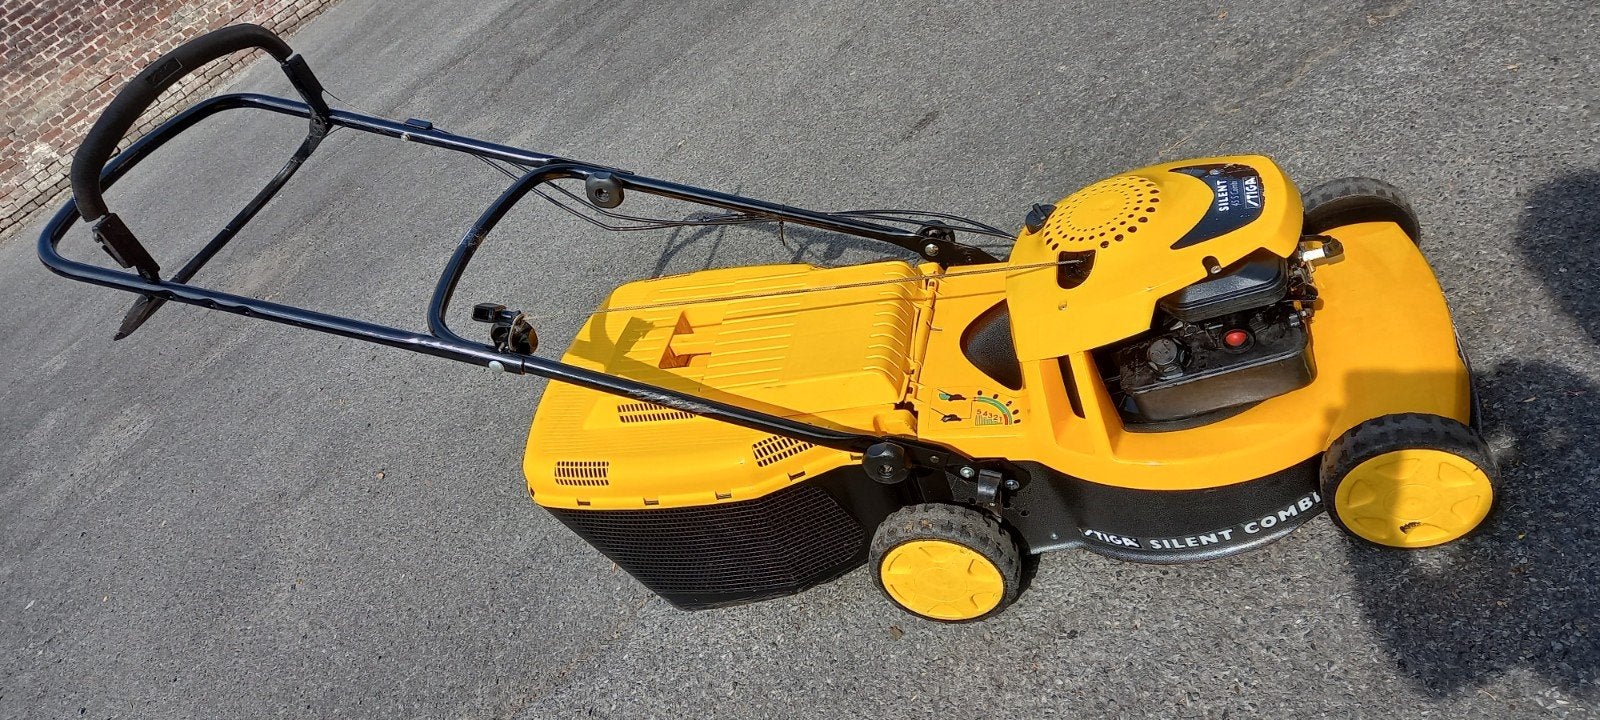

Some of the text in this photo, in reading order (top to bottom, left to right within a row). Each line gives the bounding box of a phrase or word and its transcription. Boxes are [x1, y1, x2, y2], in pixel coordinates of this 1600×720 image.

[1217, 180, 1230, 212] SILENT
[1149, 528, 1234, 550] SILENT
[1244, 491, 1322, 535] COMBI
